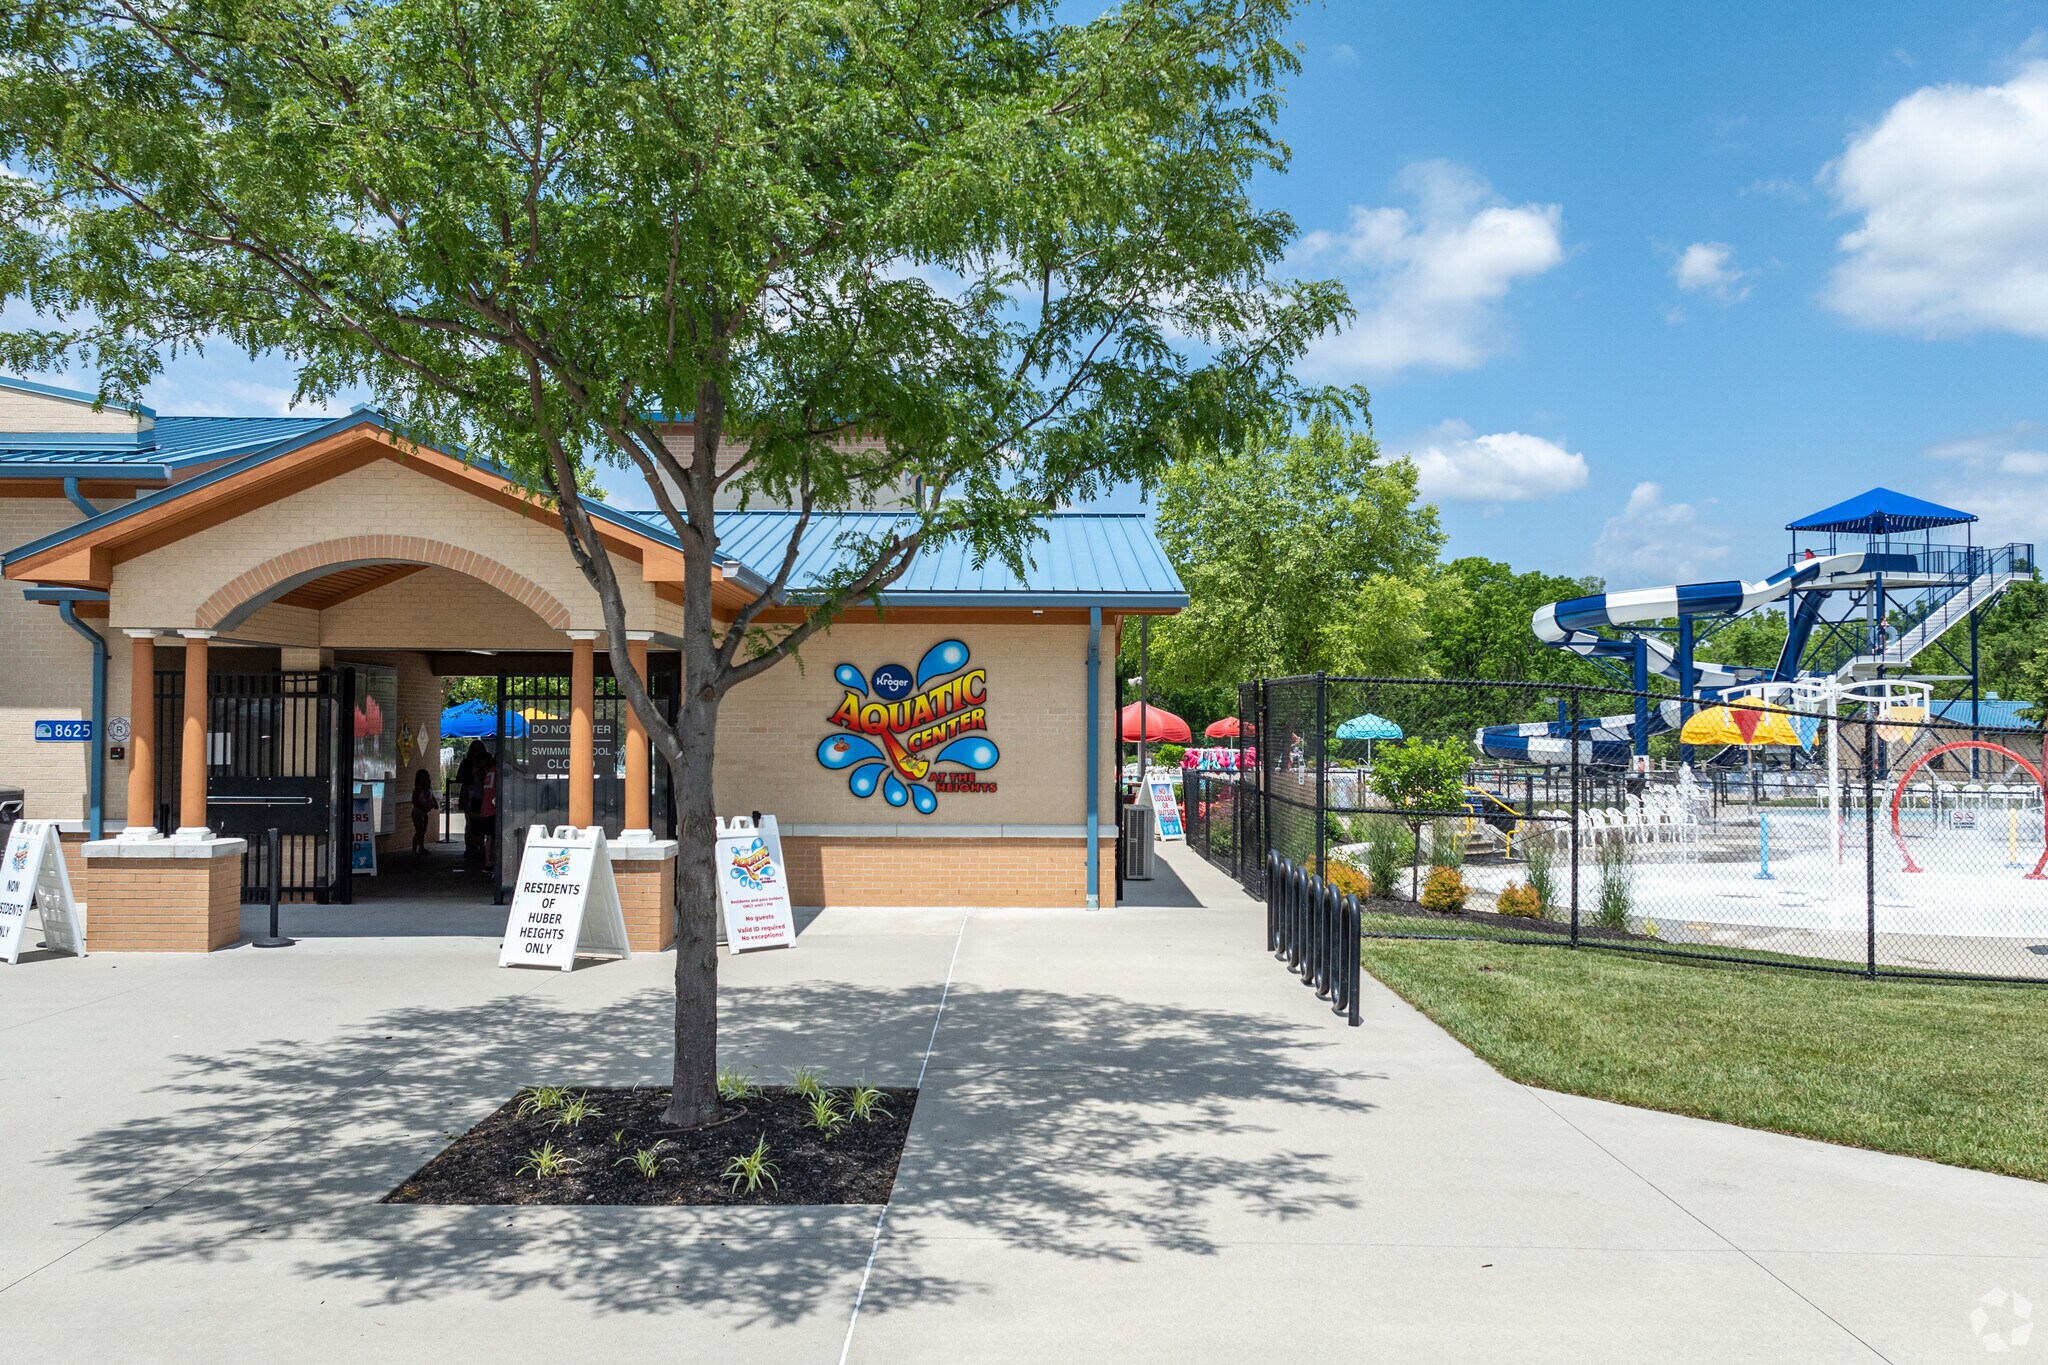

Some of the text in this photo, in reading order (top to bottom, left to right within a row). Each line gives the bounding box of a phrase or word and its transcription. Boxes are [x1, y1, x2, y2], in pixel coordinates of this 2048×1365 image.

[876, 673, 909, 692] Kroger
[826, 669, 987, 735] AQUATIC
[55, 724, 91, 737] 8625
[532, 725, 548, 734] DO
[593, 725, 611, 734] TER
[908, 708, 987, 753] CENTER
[532, 747, 570, 755] SWIMMI
[928, 772, 975, 782] AT THE
[936, 783, 998, 793] HEIGHTS
[6, 880, 20, 893] NON
[524, 882, 580, 895] RESIDENTS
[0, 902, 24, 916] SIDENTS
[542, 898, 556, 908] OF
[528, 912, 562, 924] HUBER
[0, 927, 11, 938] NLY
[520, 927, 565, 940] HEIGHTS
[761, 924, 785, 932] required
[525, 942, 552, 954] ONLY
